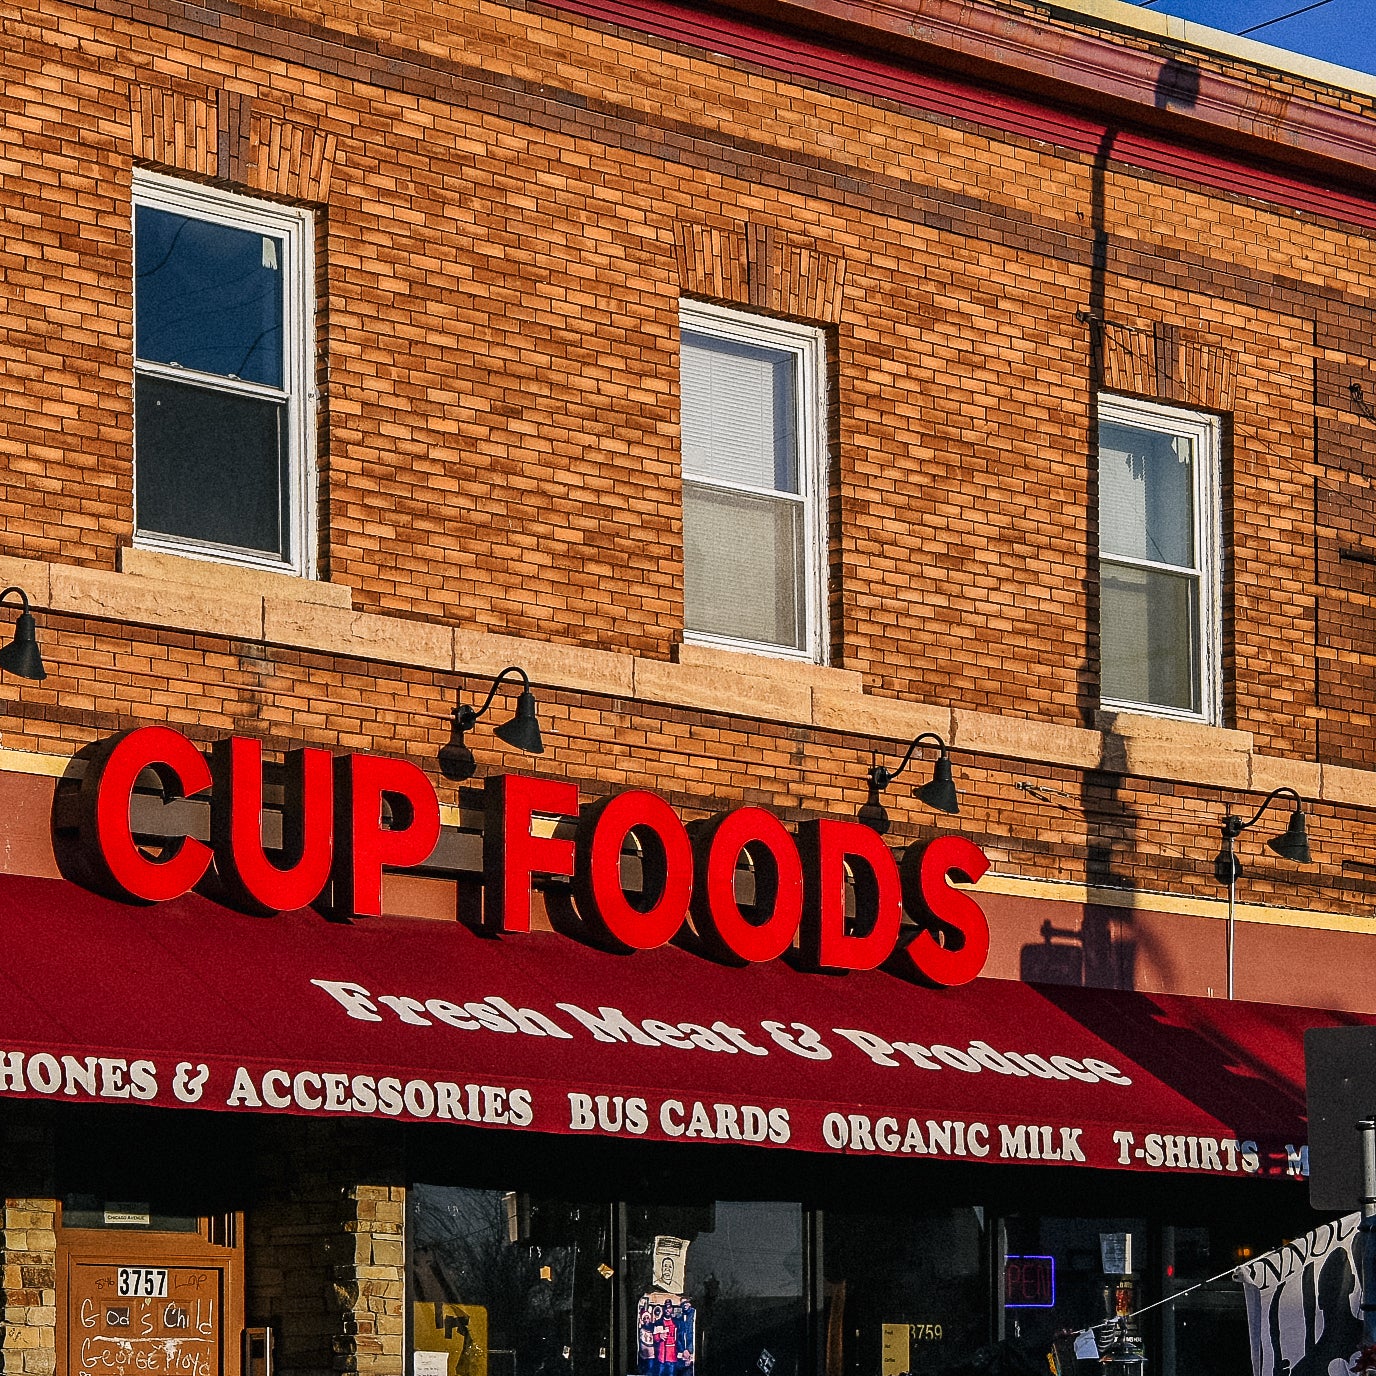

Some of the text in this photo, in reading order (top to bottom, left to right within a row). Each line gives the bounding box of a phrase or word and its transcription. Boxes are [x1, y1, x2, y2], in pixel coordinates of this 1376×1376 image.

[96, 723, 991, 987] CUP FOODS
[310, 978, 1134, 1086] Fresh Meat & Produce
[172, 1061, 209, 1102] &
[226, 1066, 534, 1127] ACCESSORIES
[567, 1091, 650, 1135] BUS
[658, 1098, 791, 1145] CARDS
[821, 1112, 992, 1159] ORGANIC
[998, 1124, 1086, 1163] MILK
[1112, 1130, 1260, 1174] T-SHIRTS
[119, 1268, 167, 1296] 3757
[1007, 1263, 1051, 1300] PEN
[80, 1298, 213, 1336] God's Child
[910, 1323, 943, 1340] 3759
